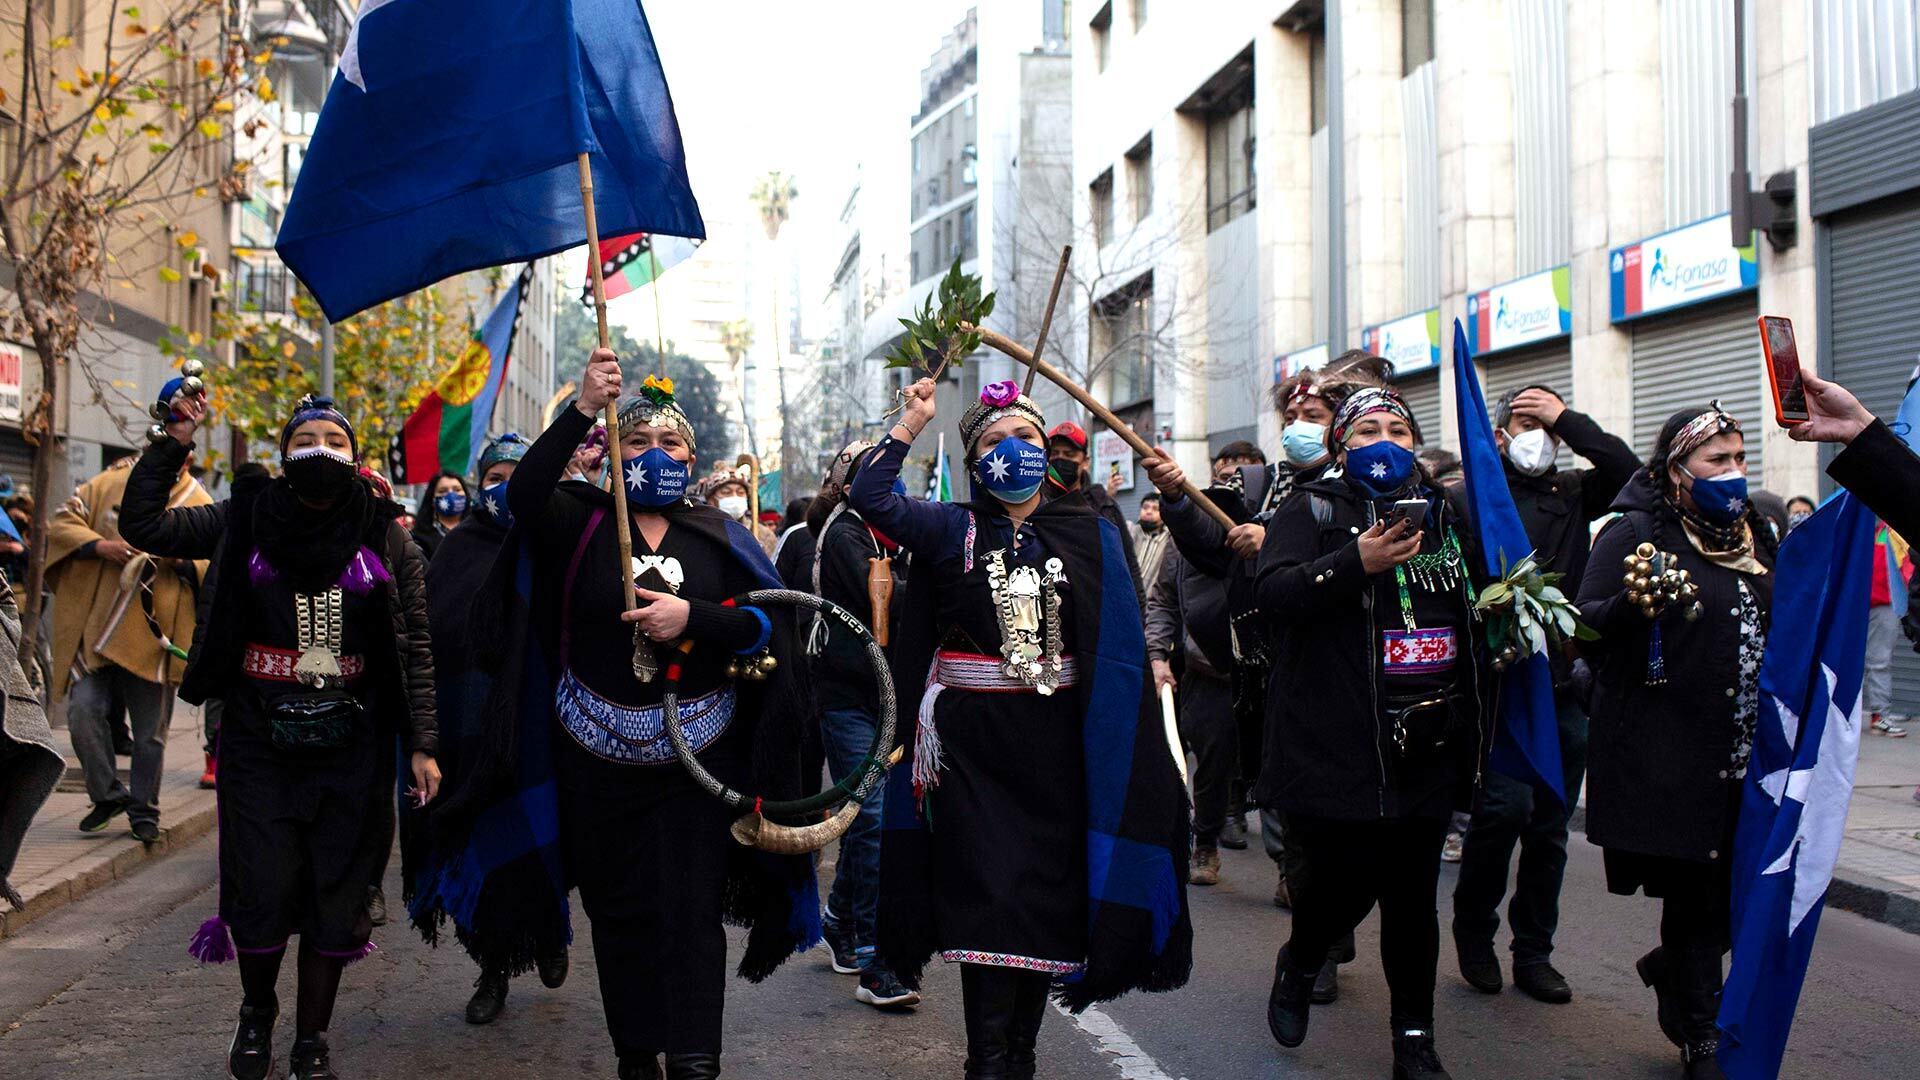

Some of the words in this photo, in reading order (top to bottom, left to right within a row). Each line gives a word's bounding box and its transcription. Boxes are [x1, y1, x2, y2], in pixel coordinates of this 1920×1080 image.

[1019, 459, 1043, 468] Justicia
[660, 468, 685, 478] Libertad
[658, 478, 682, 487] Justicia
